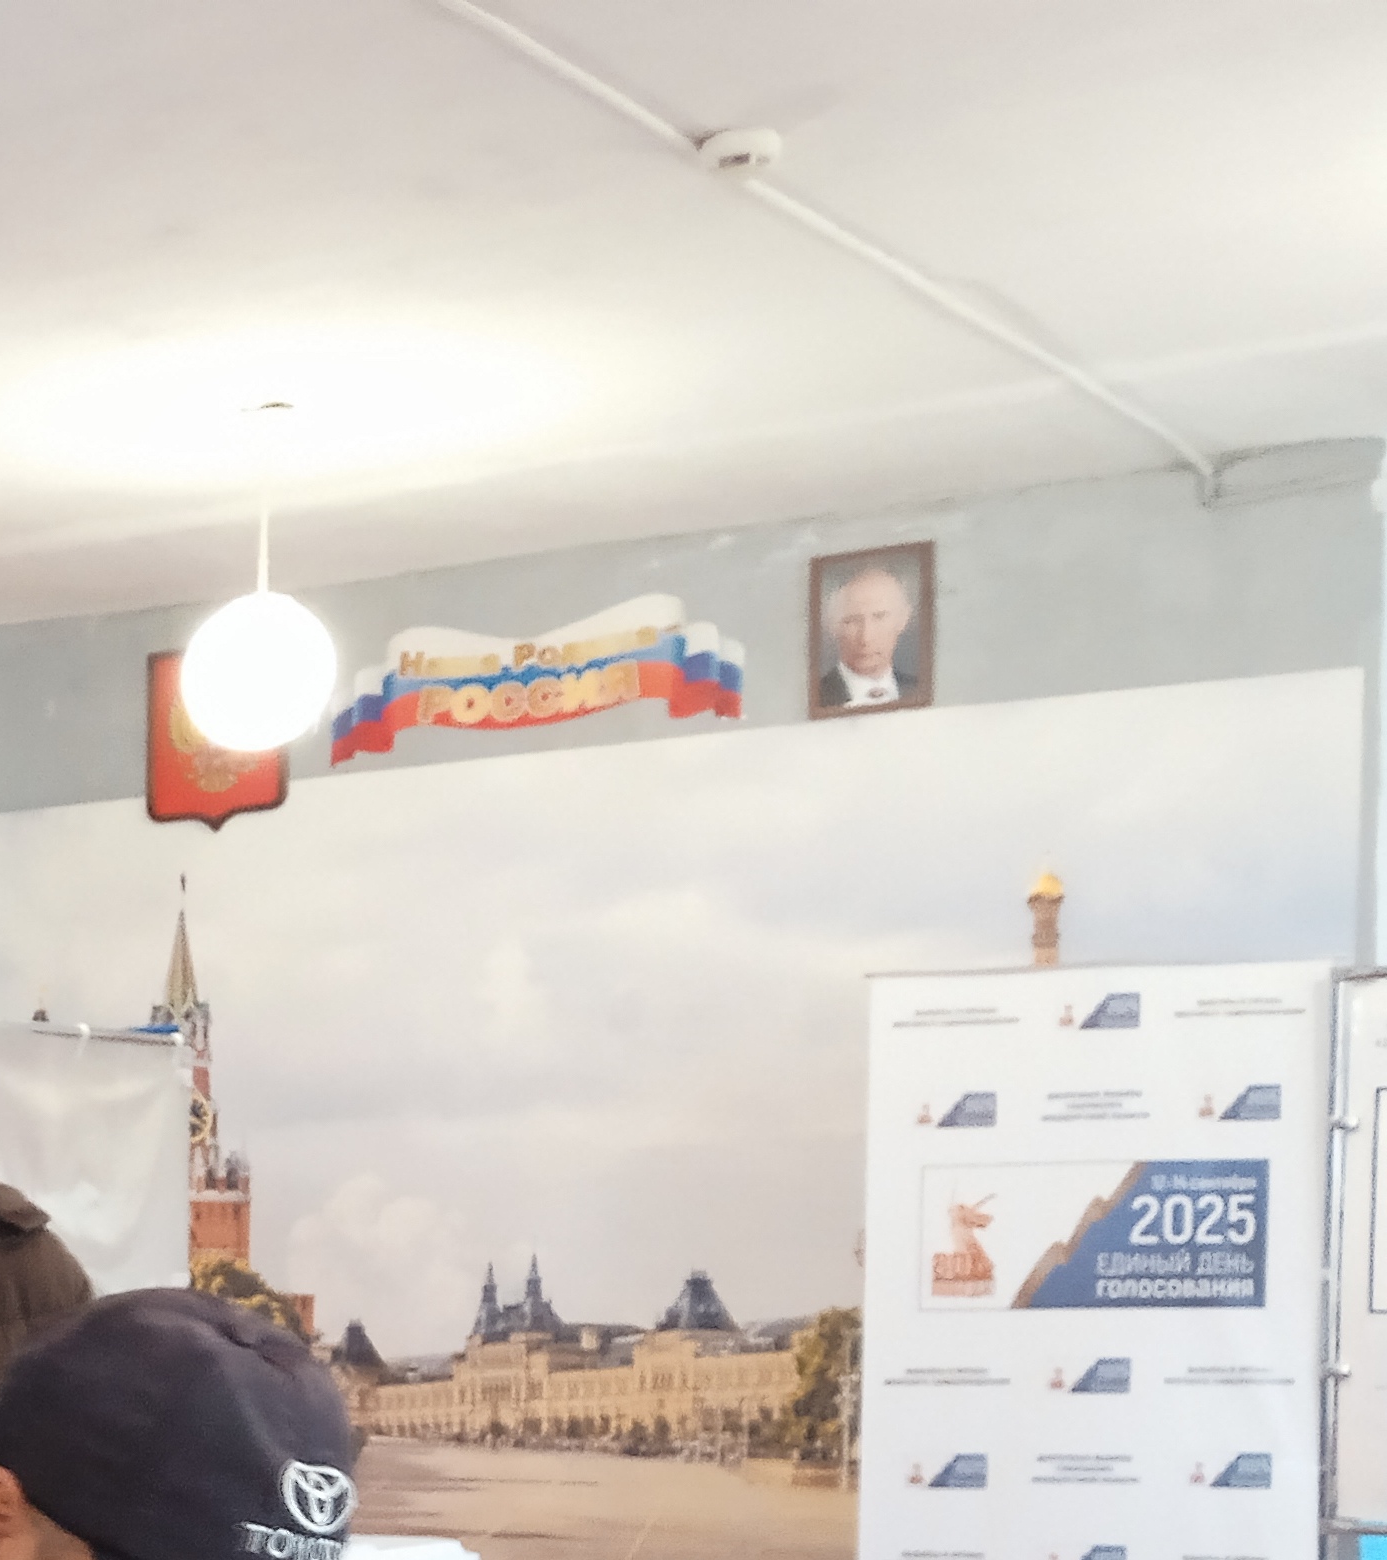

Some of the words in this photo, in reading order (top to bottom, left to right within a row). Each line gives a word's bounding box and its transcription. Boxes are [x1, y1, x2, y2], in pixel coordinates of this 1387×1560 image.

[417, 660, 640, 726] РОССИЯ
[1129, 1193, 1256, 1246] 2025
[1196, 1251, 1255, 1276] ДЕНЬ
